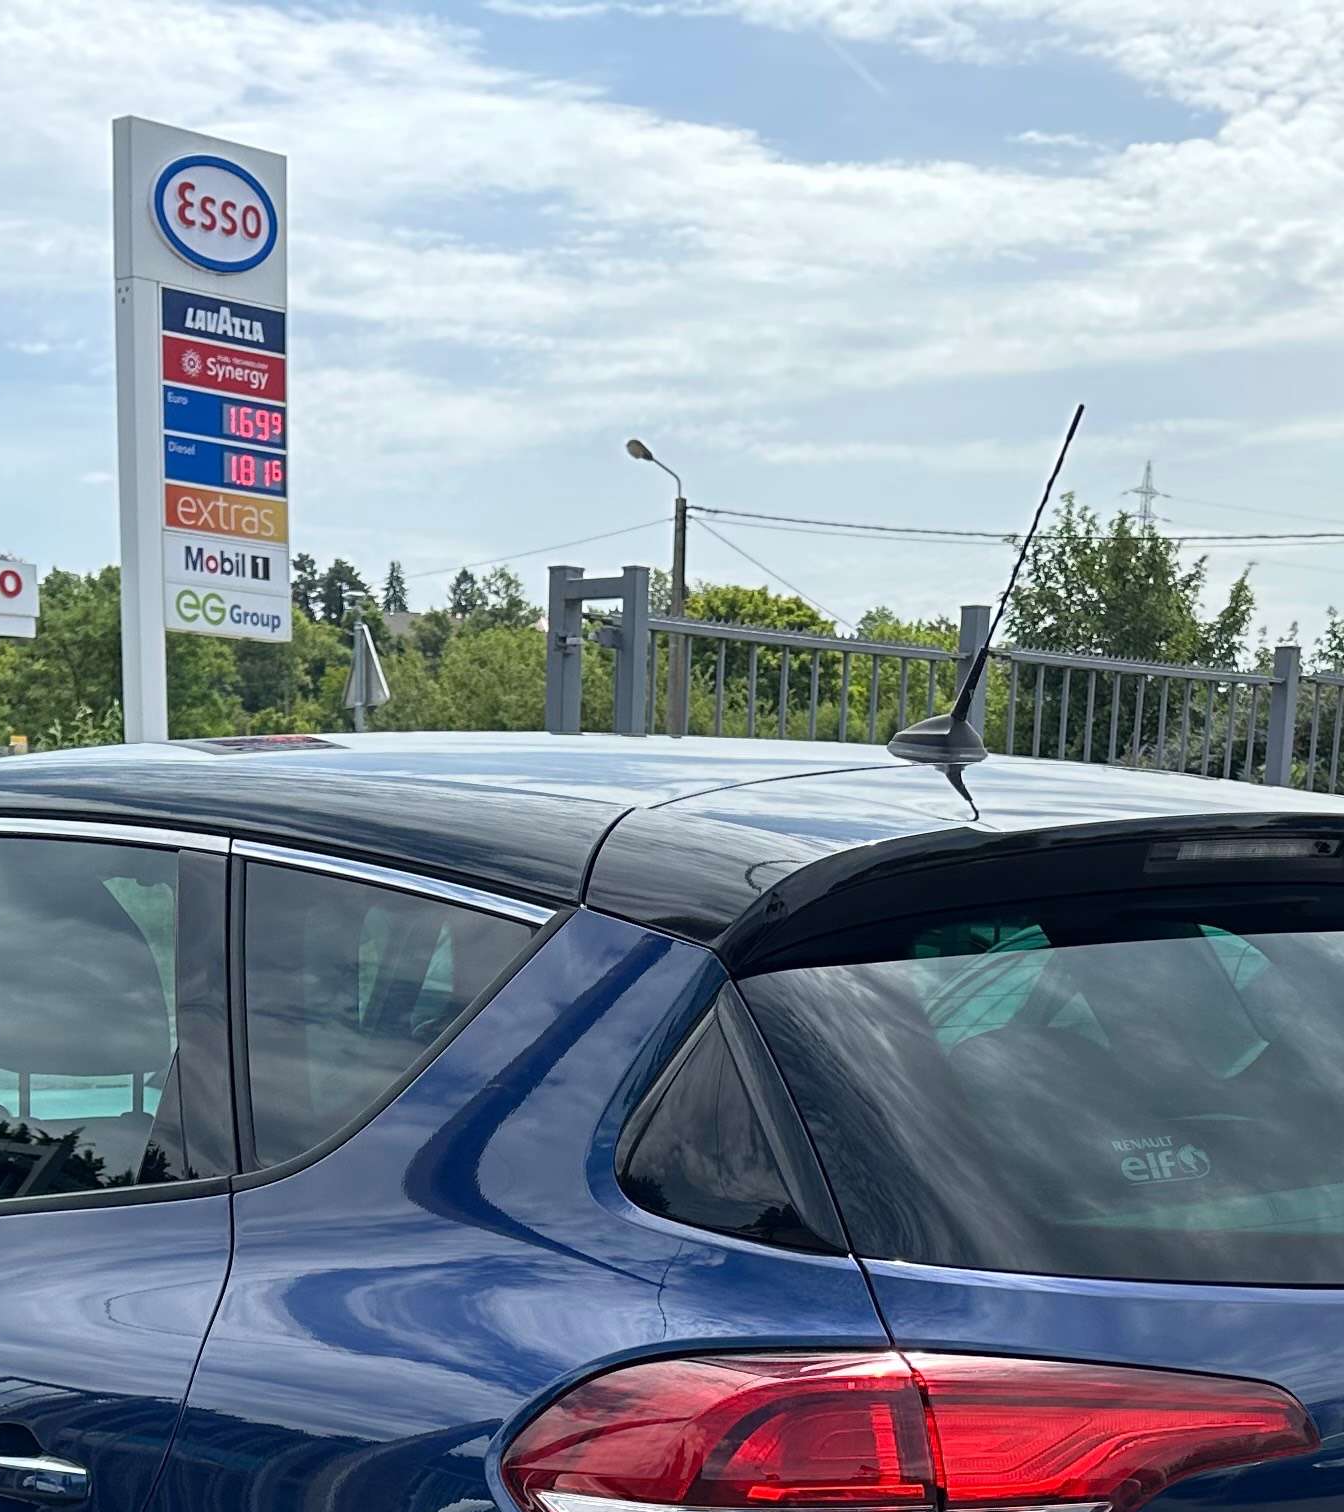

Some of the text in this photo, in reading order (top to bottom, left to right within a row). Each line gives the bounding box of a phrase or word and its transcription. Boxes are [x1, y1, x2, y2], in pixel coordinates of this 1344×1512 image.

[184, 306, 265, 343] LAVAZZA
[206, 357, 269, 390] Synergy
[167, 441, 196, 455] Diesel
[176, 494, 275, 537] extras
[184, 546, 246, 578] Mobil
[230, 604, 281, 632] Group
[1112, 1135, 1173, 1151] RENAULT
[1121, 1150, 1176, 1181] elf
